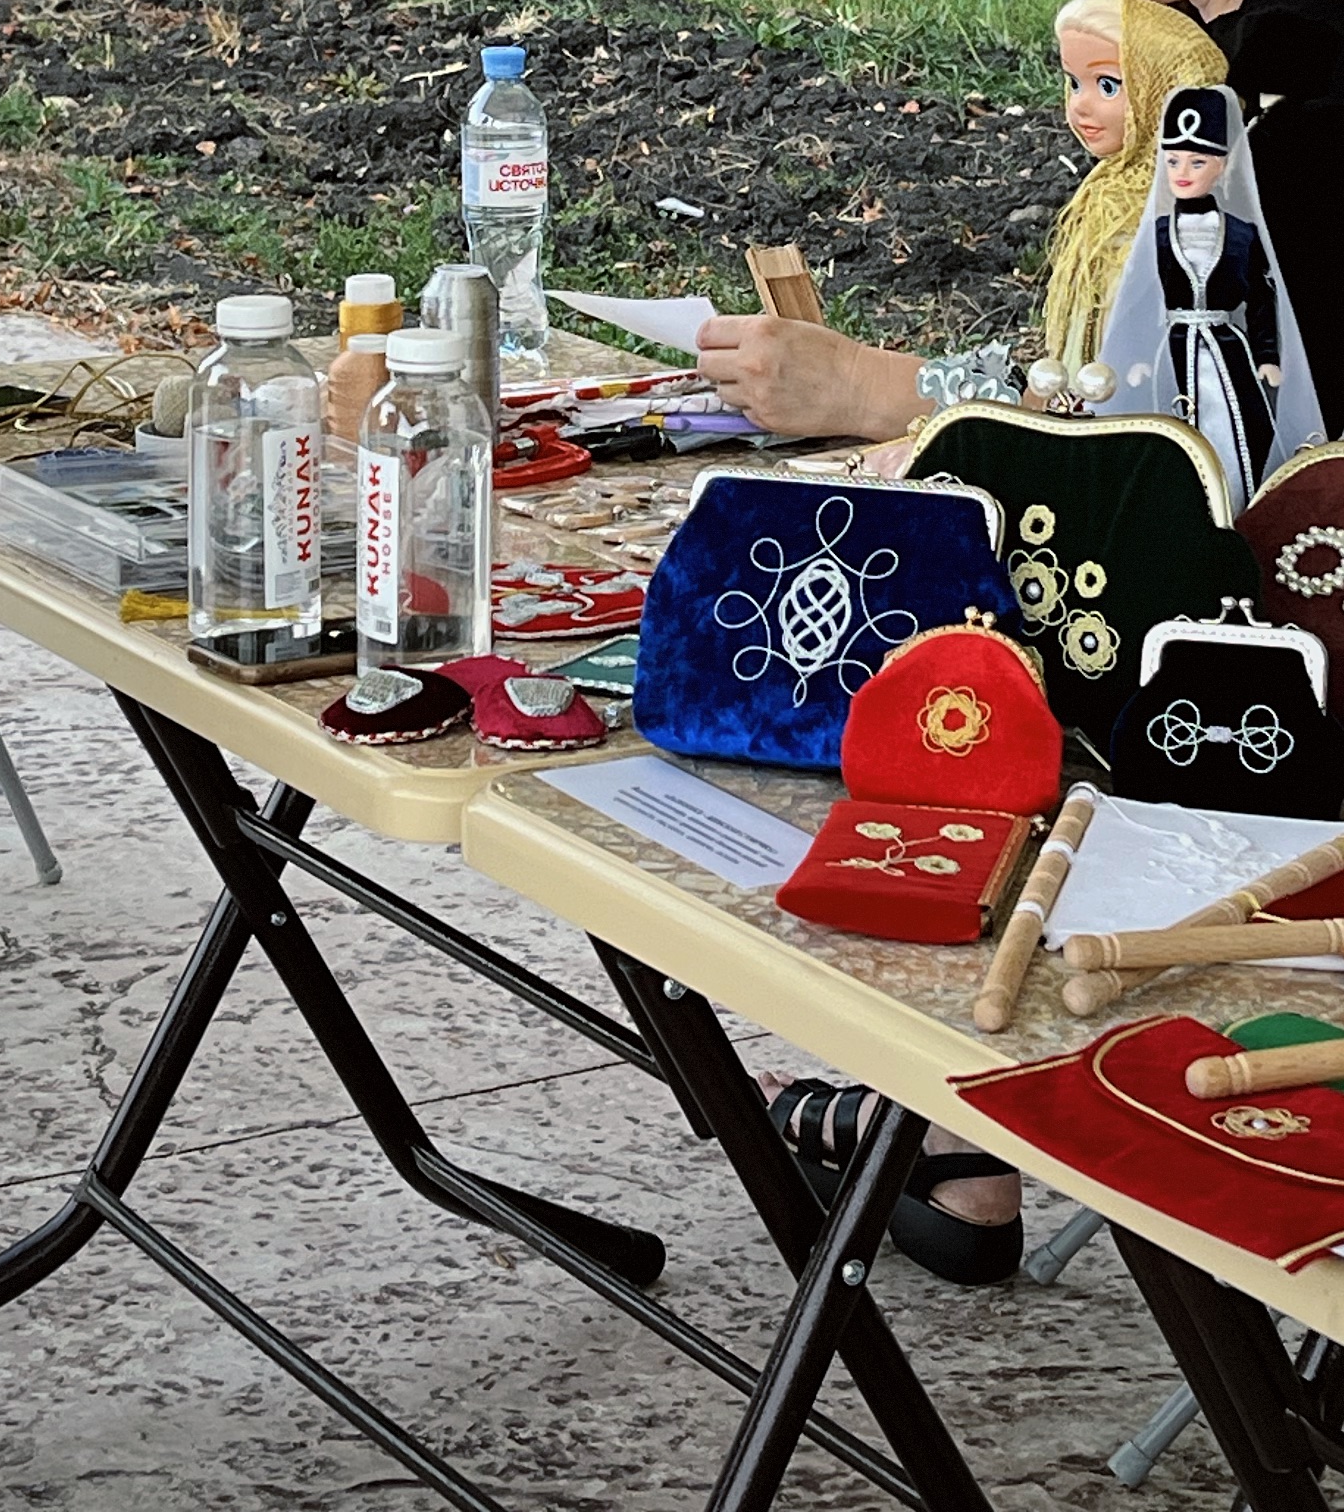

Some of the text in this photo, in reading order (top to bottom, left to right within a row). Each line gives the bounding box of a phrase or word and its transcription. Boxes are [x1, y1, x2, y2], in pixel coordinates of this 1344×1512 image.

[296, 435, 312, 562] KUNAK
[367, 462, 381, 597] KUNAK
[382, 492, 392, 575] HOUSE
